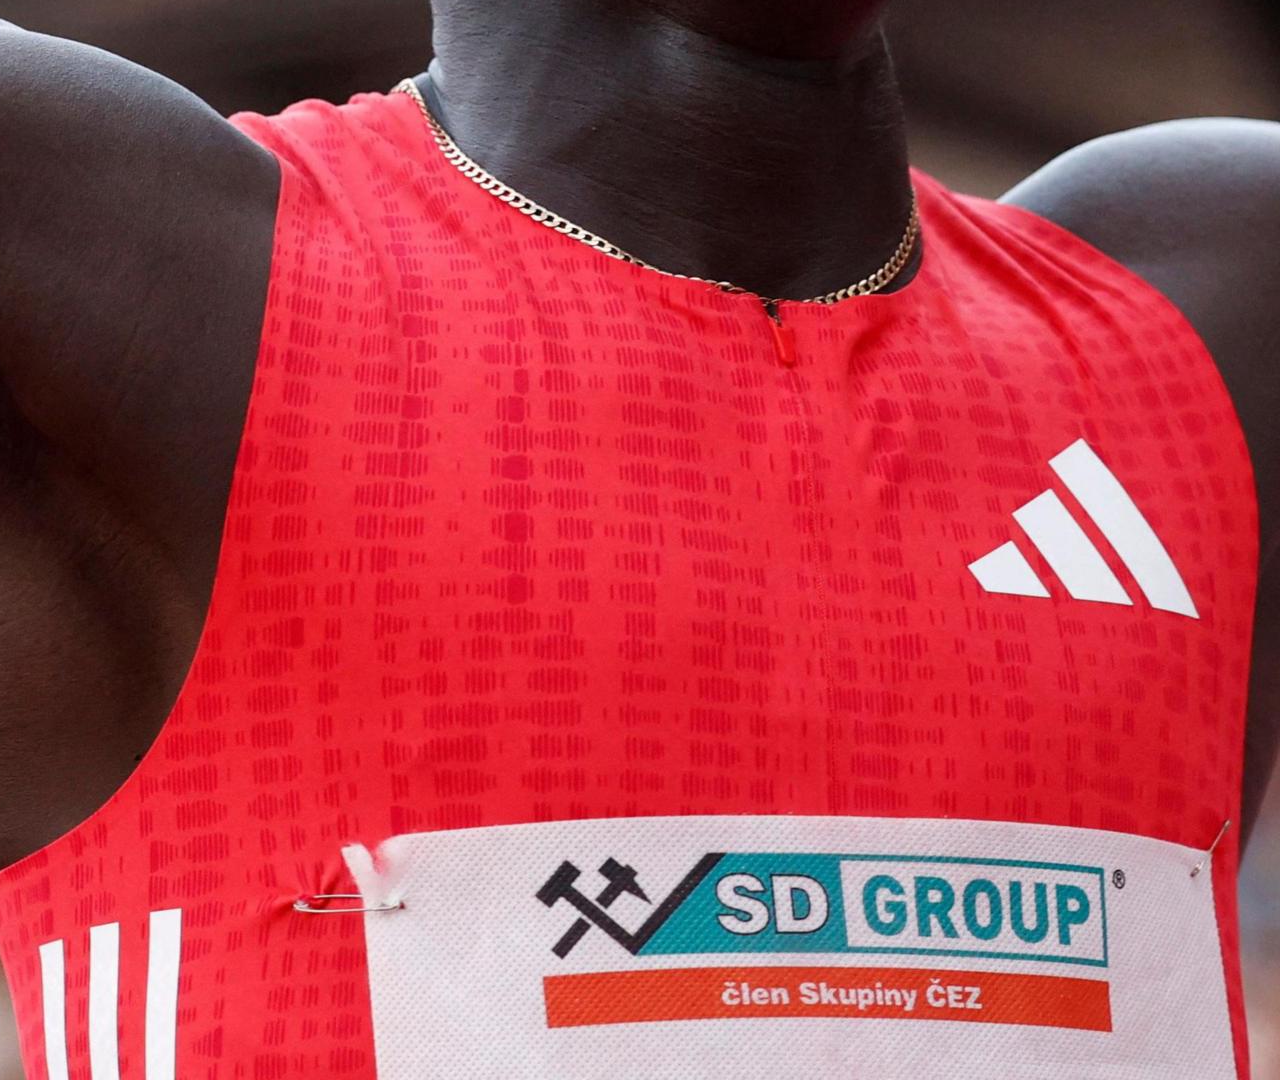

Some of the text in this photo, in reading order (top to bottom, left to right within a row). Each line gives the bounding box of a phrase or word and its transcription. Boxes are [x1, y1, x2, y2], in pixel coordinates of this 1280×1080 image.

[716, 872, 1091, 945] SD GROUP
[721, 978, 983, 1012] člen Skupiny ČEZ
